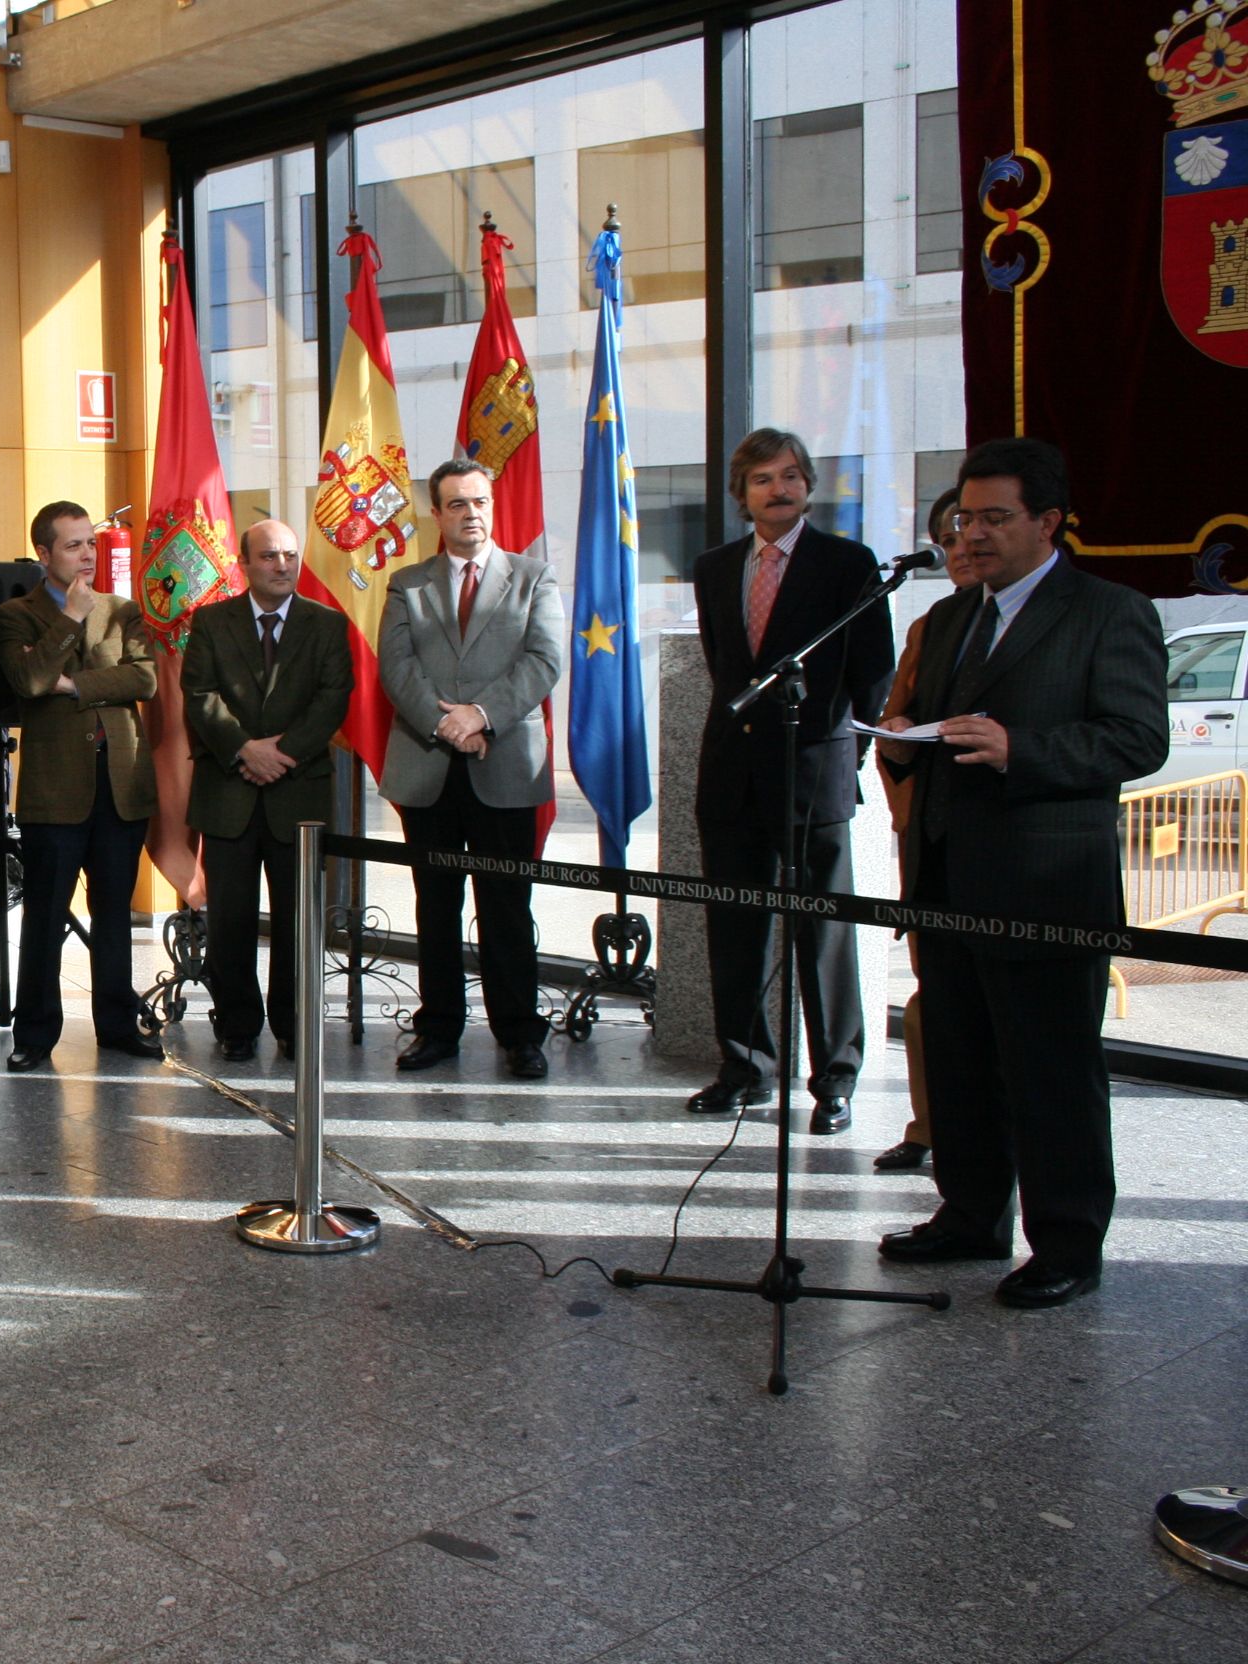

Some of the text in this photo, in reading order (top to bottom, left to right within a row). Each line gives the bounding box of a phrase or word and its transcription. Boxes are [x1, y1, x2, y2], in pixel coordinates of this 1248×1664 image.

[428, 851, 600, 886] UNIVERSIDAD DE BURGOS
[629, 875, 837, 915] UNIVERSIDAD DE BURGOS
[874, 904, 1133, 952] UNIVERSIDAD DE BURGOS
